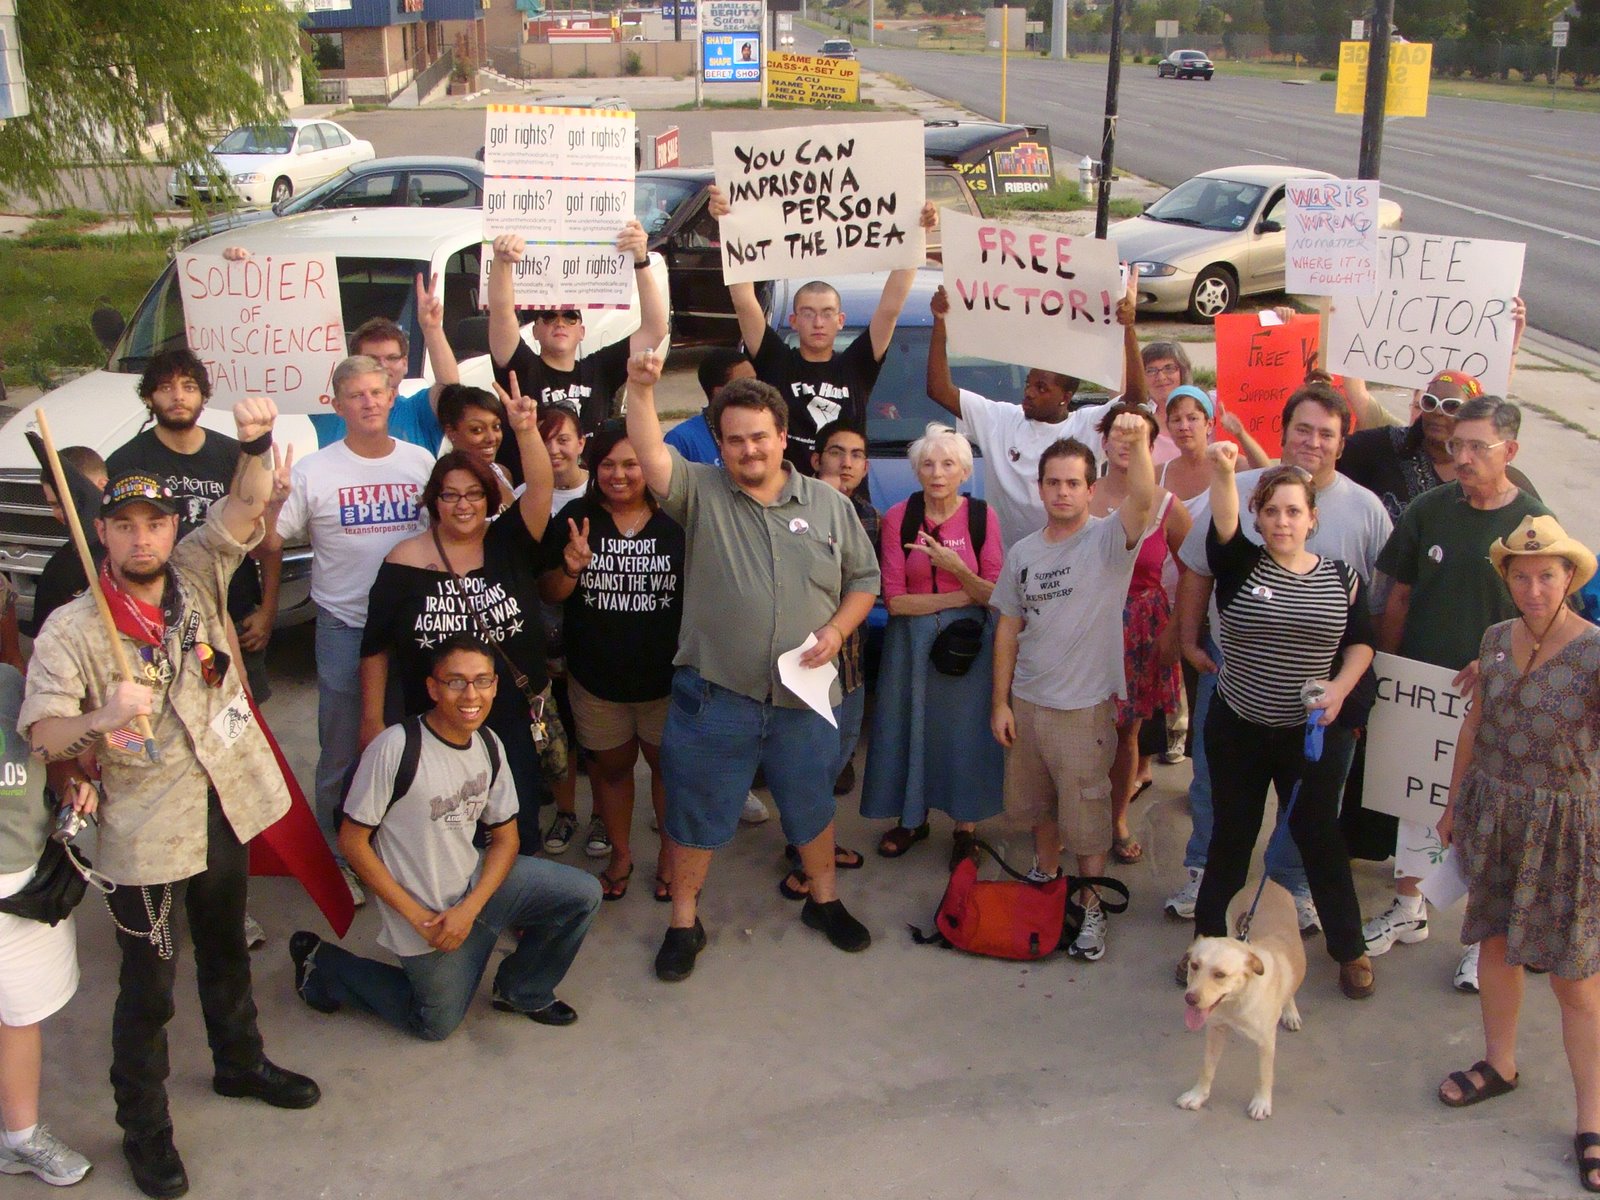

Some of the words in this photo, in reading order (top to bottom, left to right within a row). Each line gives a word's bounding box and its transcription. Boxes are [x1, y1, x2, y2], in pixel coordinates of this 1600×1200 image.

[679, 6, 696, 16] TAX
[710, 9, 760, 17] BEAUTY
[709, 57, 732, 66] SHAPE
[782, 54, 811, 64] SAME
[816, 58, 839, 67] DAY
[706, 70, 733, 78] BERET
[736, 70, 759, 78] SHOP
[795, 75, 820, 83] ACU
[840, 69, 853, 77] UP
[771, 80, 804, 88] NAME
[809, 83, 846, 94] TAPES
[775, 87, 806, 95] HEAD
[811, 91, 842, 100] BAND
[490, 124, 508, 148] got
[514, 123, 554, 149] rights?
[568, 128, 585, 150] got
[591, 127, 627, 152] rights?
[657, 142, 668, 169] FOR
[667, 136, 678, 162] SALE
[734, 146, 785, 174] YOU
[795, 138, 855, 165] CAN
[729, 167, 833, 206] IMPRISON
[840, 166, 860, 193] A
[1004, 182, 1049, 193] RIBBON
[1287, 183, 1342, 208] WAR
[488, 190, 506, 214] got
[513, 189, 553, 215] rights?
[566, 192, 584, 216] got
[590, 191, 627, 216] rights?
[782, 192, 896, 224] PERSON
[1295, 212, 1372, 239] WRONG
[726, 236, 772, 268] NOT
[784, 230, 828, 260] THE
[836, 221, 905, 250] IDEA
[978, 227, 1076, 279] FREE
[515, 254, 551, 279] ights?
[562, 256, 581, 279] got
[586, 254, 625, 279] rights?
[1292, 257, 1333, 270] WHERE
[1340, 256, 1356, 268] IT
[955, 278, 1111, 325] VICTOR!
[240, 305, 262, 324] OF
[1343, 333, 1489, 378] AGOSTO
[1239, 382, 1288, 403] SUPPORT
[1250, 416, 1265, 431] OF
[341, 485, 418, 506] TEXANS
[344, 507, 355, 524] FOR
[358, 500, 417, 522] PEACE
[345, 523, 417, 535] texansforpeace.org
[601, 537, 605, 553] I
[607, 538, 657, 555] SUPPORT
[616, 555, 671, 573] VETERANS
[1034, 566, 1071, 580] SUPPORT
[437, 581, 443, 595] I
[580, 571, 625, 592] AGAINST
[627, 574, 648, 592] THE
[650, 574, 677, 592] WAR
[1040, 580, 1061, 590] WAR
[598, 592, 657, 612] IVAW.ORG
[1026, 587, 1073, 601] RESISTERS
[414, 613, 467, 632] AGAINST
[489, 597, 521, 625] WAR
[426, 596, 455, 613] IRAQ
[1376, 676, 1473, 720] CHRIS
